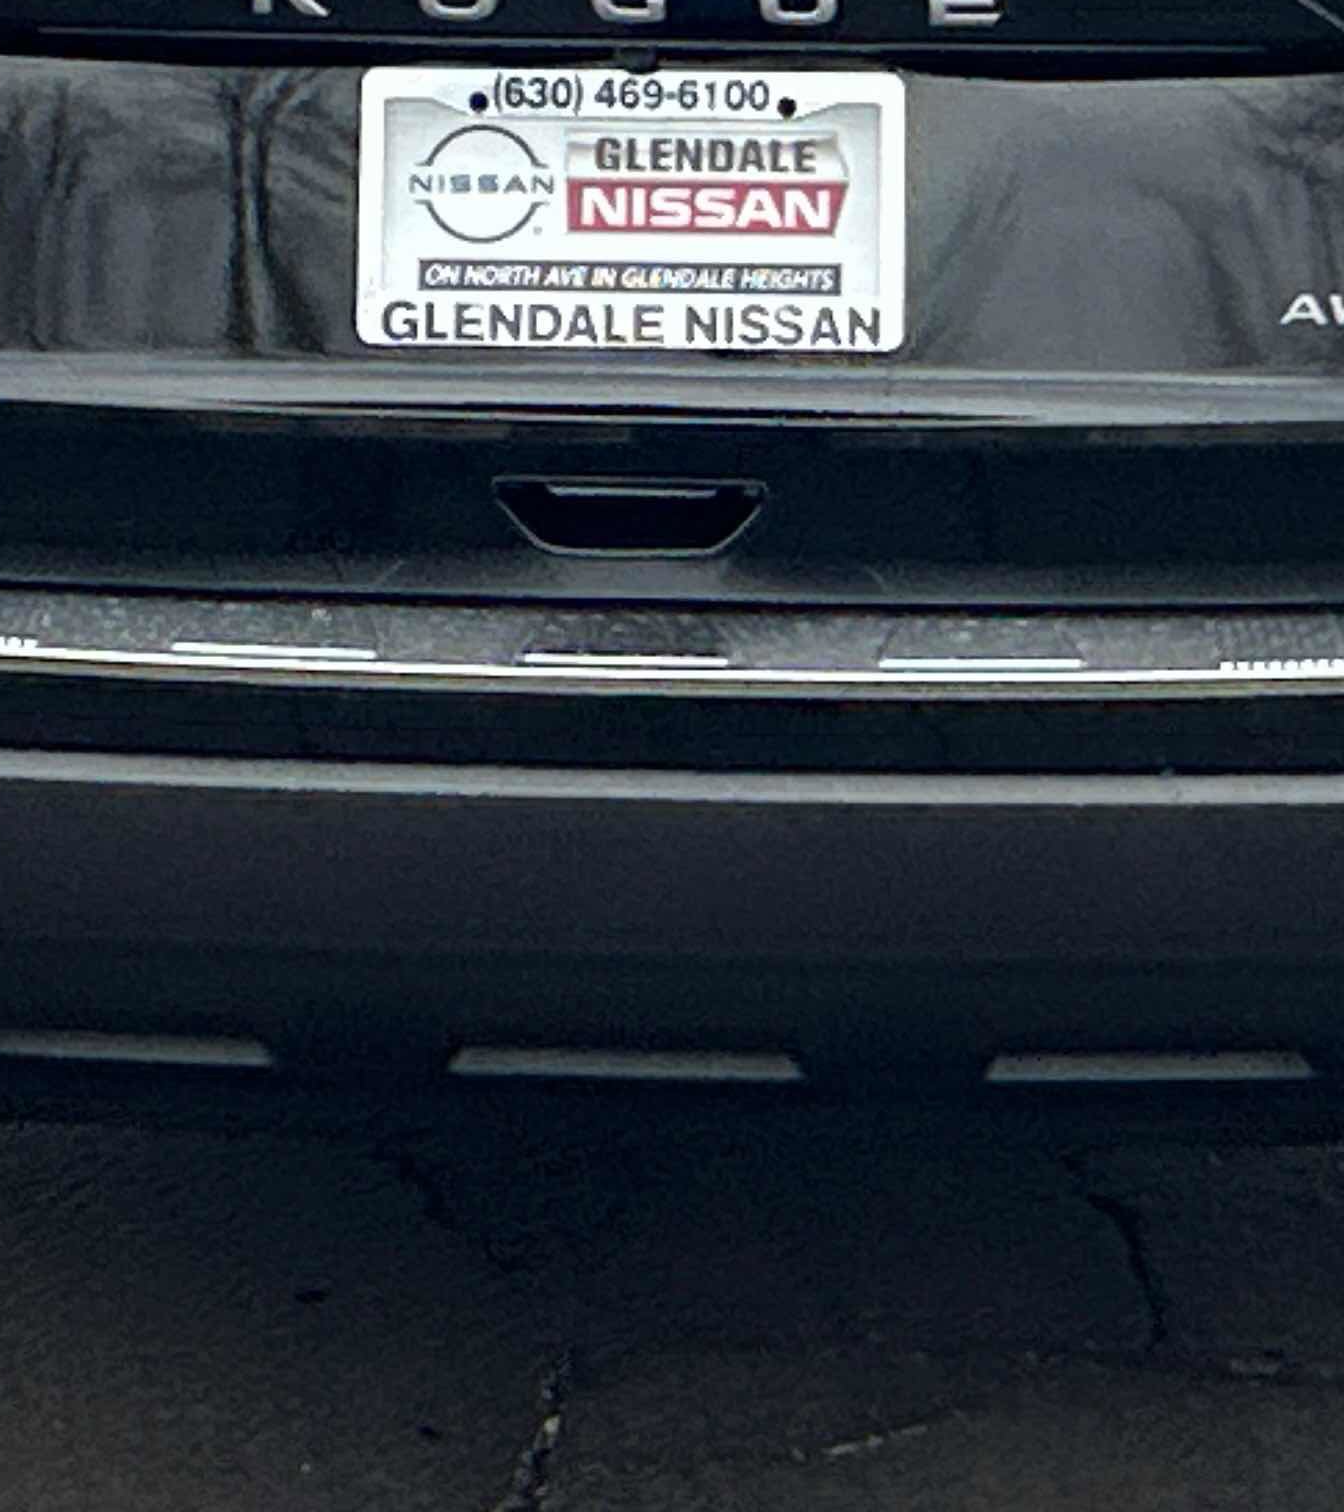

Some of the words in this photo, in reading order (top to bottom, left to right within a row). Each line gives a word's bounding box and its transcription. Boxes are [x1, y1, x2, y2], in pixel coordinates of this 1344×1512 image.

[494, 72, 583, 116] (630)
[594, 77, 770, 111] 469-6100
[594, 137, 817, 173] GLENDALE
[409, 173, 555, 194] NISSAN
[580, 186, 831, 229] NISSAN
[424, 264, 460, 286] ON
[464, 265, 540, 287] NORTH
[544, 266, 588, 287] AVE
[591, 266, 617, 287] IN
[621, 266, 736, 289] GLENDALE
[740, 268, 835, 291] HEIGHTS
[382, 300, 665, 344] GLENDALE
[684, 304, 882, 346] NISSAN
